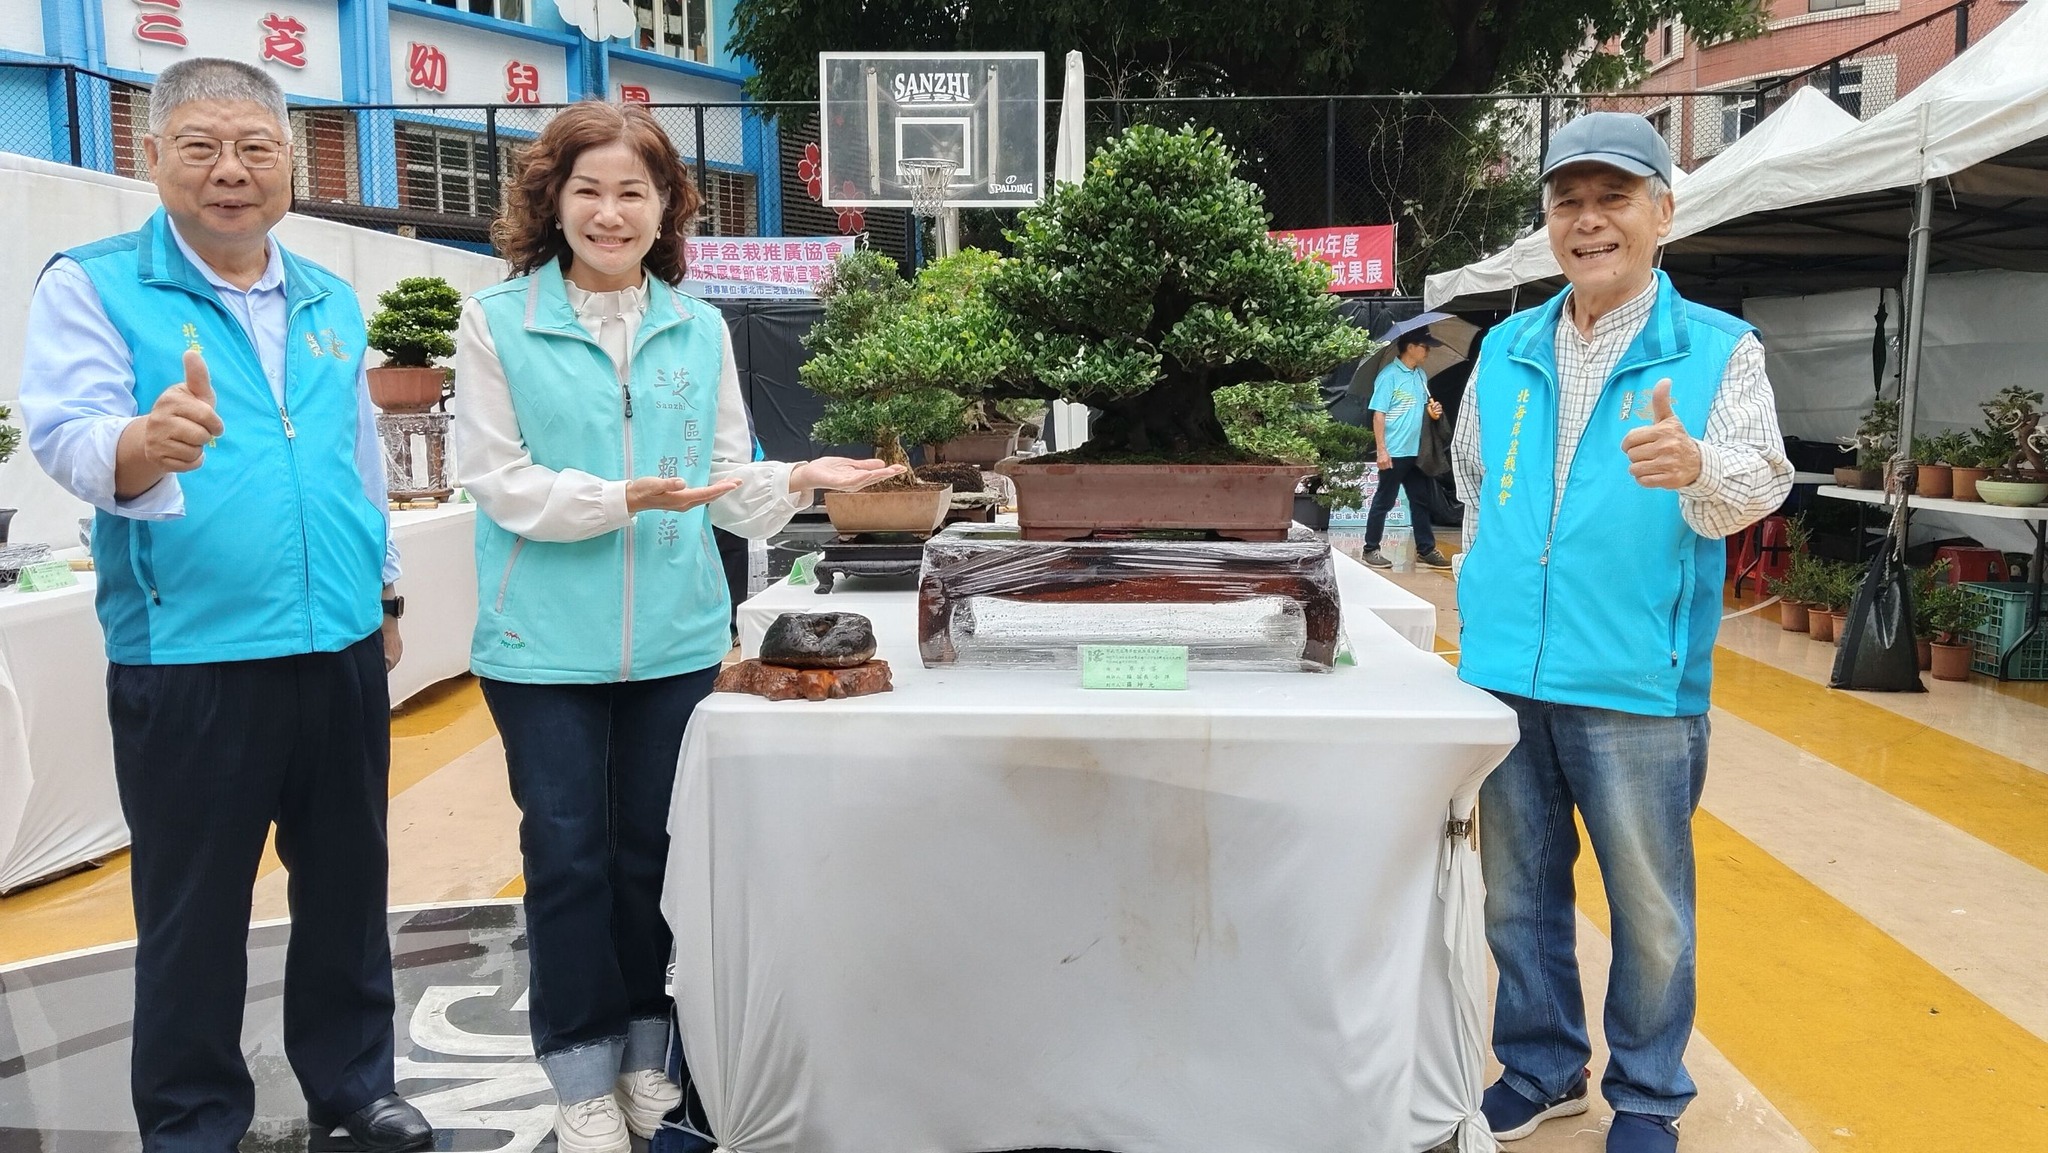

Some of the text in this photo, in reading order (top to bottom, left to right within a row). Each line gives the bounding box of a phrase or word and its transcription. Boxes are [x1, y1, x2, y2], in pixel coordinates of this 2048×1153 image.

[894, 72, 971, 100] SANZHI
[989, 182, 1034, 195] SPALDING
[656, 401, 687, 411] Sanzhi
[684, 419, 702, 468] 區長
[657, 455, 680, 547] 賴萍
